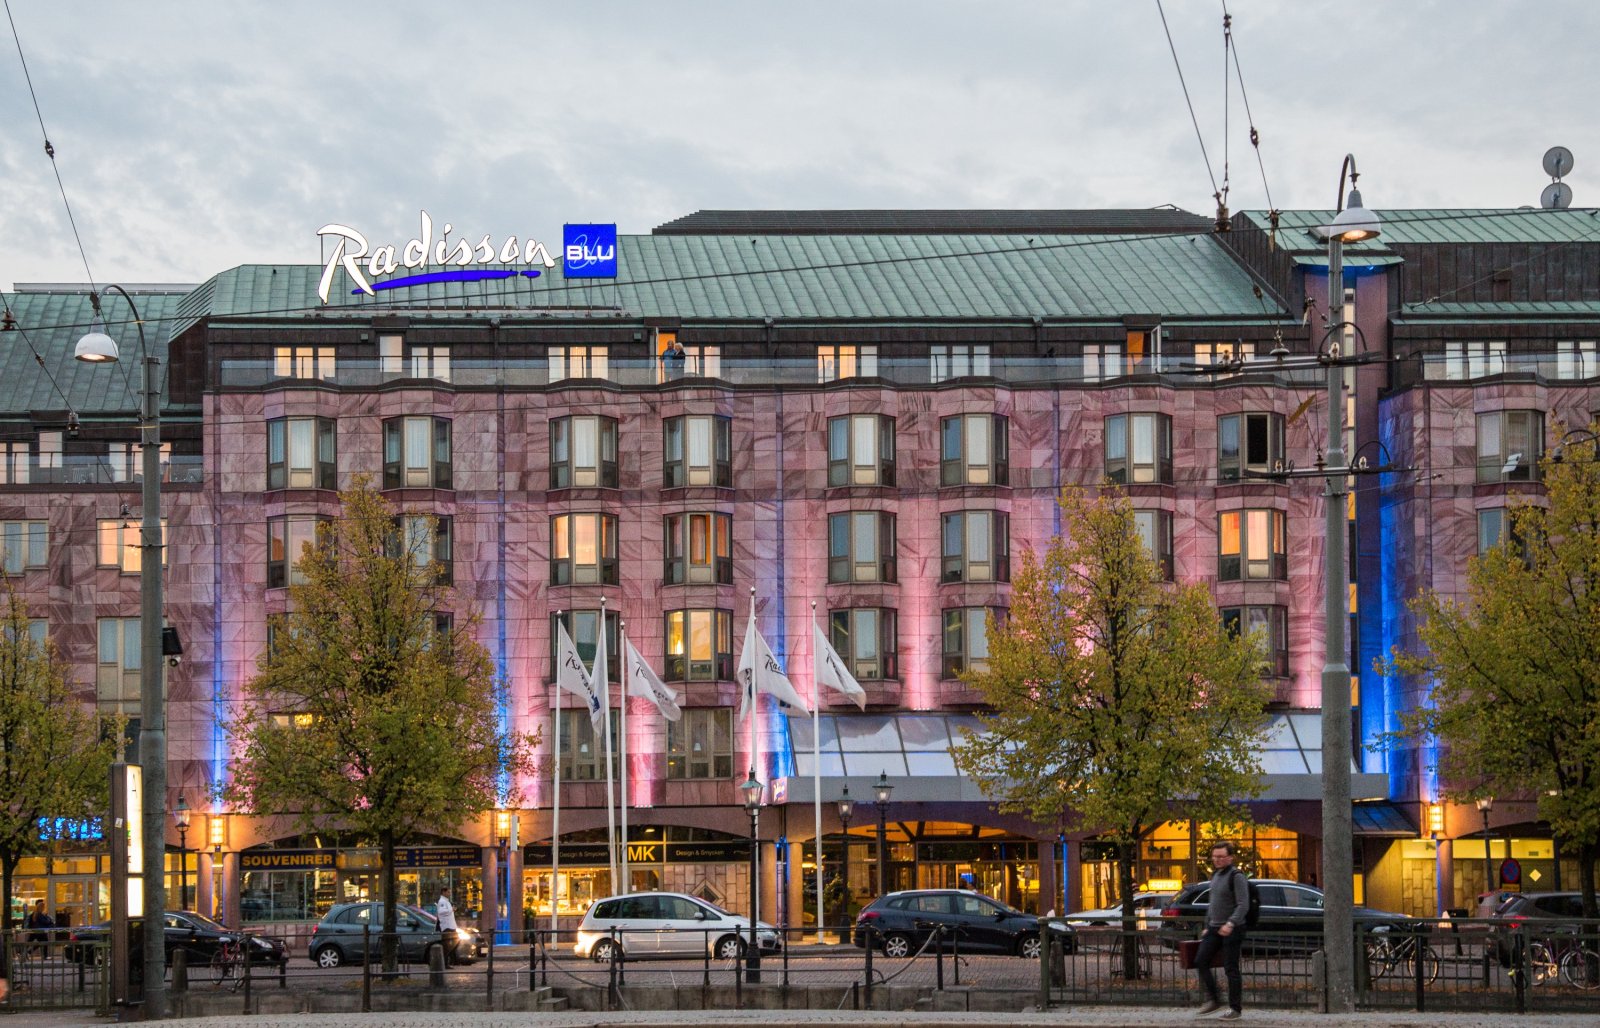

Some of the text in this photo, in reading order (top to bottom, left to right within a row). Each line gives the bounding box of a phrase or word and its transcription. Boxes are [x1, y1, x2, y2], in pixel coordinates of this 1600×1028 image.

[317, 209, 614, 305] Radisson BLU
[242, 854, 333, 867] SOUVENIRER
[627, 845, 656, 862] MK
